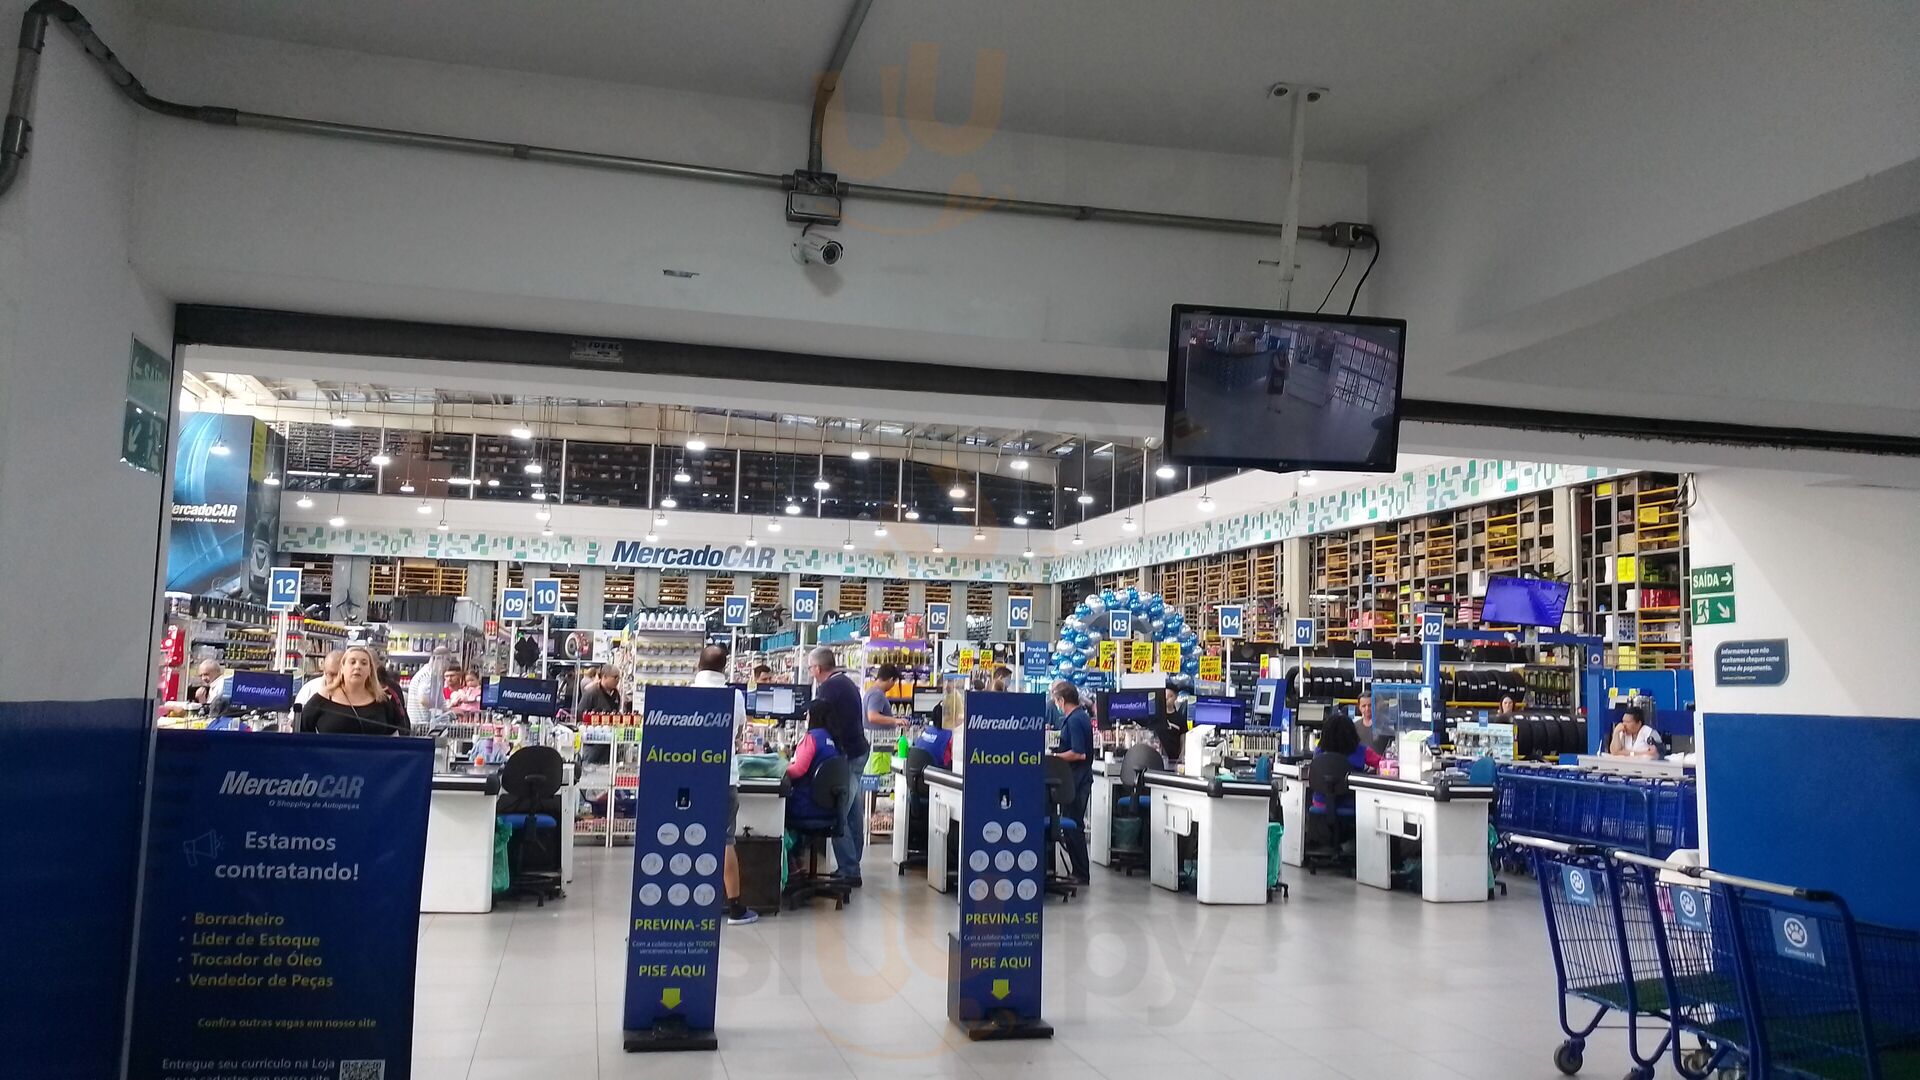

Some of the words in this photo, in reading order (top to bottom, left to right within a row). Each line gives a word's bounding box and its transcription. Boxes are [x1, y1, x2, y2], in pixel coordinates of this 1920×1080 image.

[612, 540, 776, 569] MercadoCAR
[276, 579, 296, 594] 12
[1693, 571, 1719, 588] SAÍDA
[537, 589, 555, 604] 10
[506, 598, 523, 612] 09
[728, 605, 744, 618] 07
[795, 598, 814, 613] 08
[931, 612, 946, 625] 05
[1011, 607, 1029, 620] 06
[1113, 619, 1127, 631] 03
[1222, 615, 1240, 628] 04
[1297, 627, 1310, 638] 01
[1425, 623, 1440, 636] 02
[236, 685, 287, 697] MercadoCAR
[502, 690, 551, 701] MercadoCAR
[646, 710, 731, 727] MercadoCAR
[968, 714, 1043, 731] MercadoCAR
[646, 745, 696, 763] Álcool
[701, 749, 727, 764] Gel
[970, 748, 1014, 764] Álcool
[1018, 751, 1041, 765] Gel
[219, 771, 365, 799] MercadoCAR
[276, 800, 310, 809] Shopping
[245, 831, 336, 851] Estamos
[215, 862, 359, 881] contratando!
[194, 911, 285, 926] Borracheiro
[635, 919, 716, 931] PREVINA-SE
[965, 913, 1038, 925] PREVINA-SE
[192, 932, 230, 946] Líder
[236, 933, 254, 946] de
[259, 933, 320, 949] Estoque
[191, 952, 260, 966] Trocador
[263, 953, 282, 966] de
[287, 950, 322, 966] Óleo
[971, 957, 996, 969] PISE
[1000, 957, 1031, 969] AQUI
[639, 965, 666, 977] PISE
[671, 965, 705, 977] AQUI
[189, 973, 264, 987] Vendedor
[267, 973, 287, 987] de
[291, 974, 333, 989] Peças
[198, 1017, 236, 1028] Confira
[239, 1019, 272, 1028] outras
[274, 1020, 304, 1030] vagas
[307, 1020, 322, 1028] em
[325, 1020, 356, 1028] nosso
[358, 1018, 376, 1028] site
[162, 1058, 215, 1072] Entregue
[217, 1060, 237, 1069] seu
[294, 1061, 308, 1069] na
[311, 1058, 335, 1071] Loja
